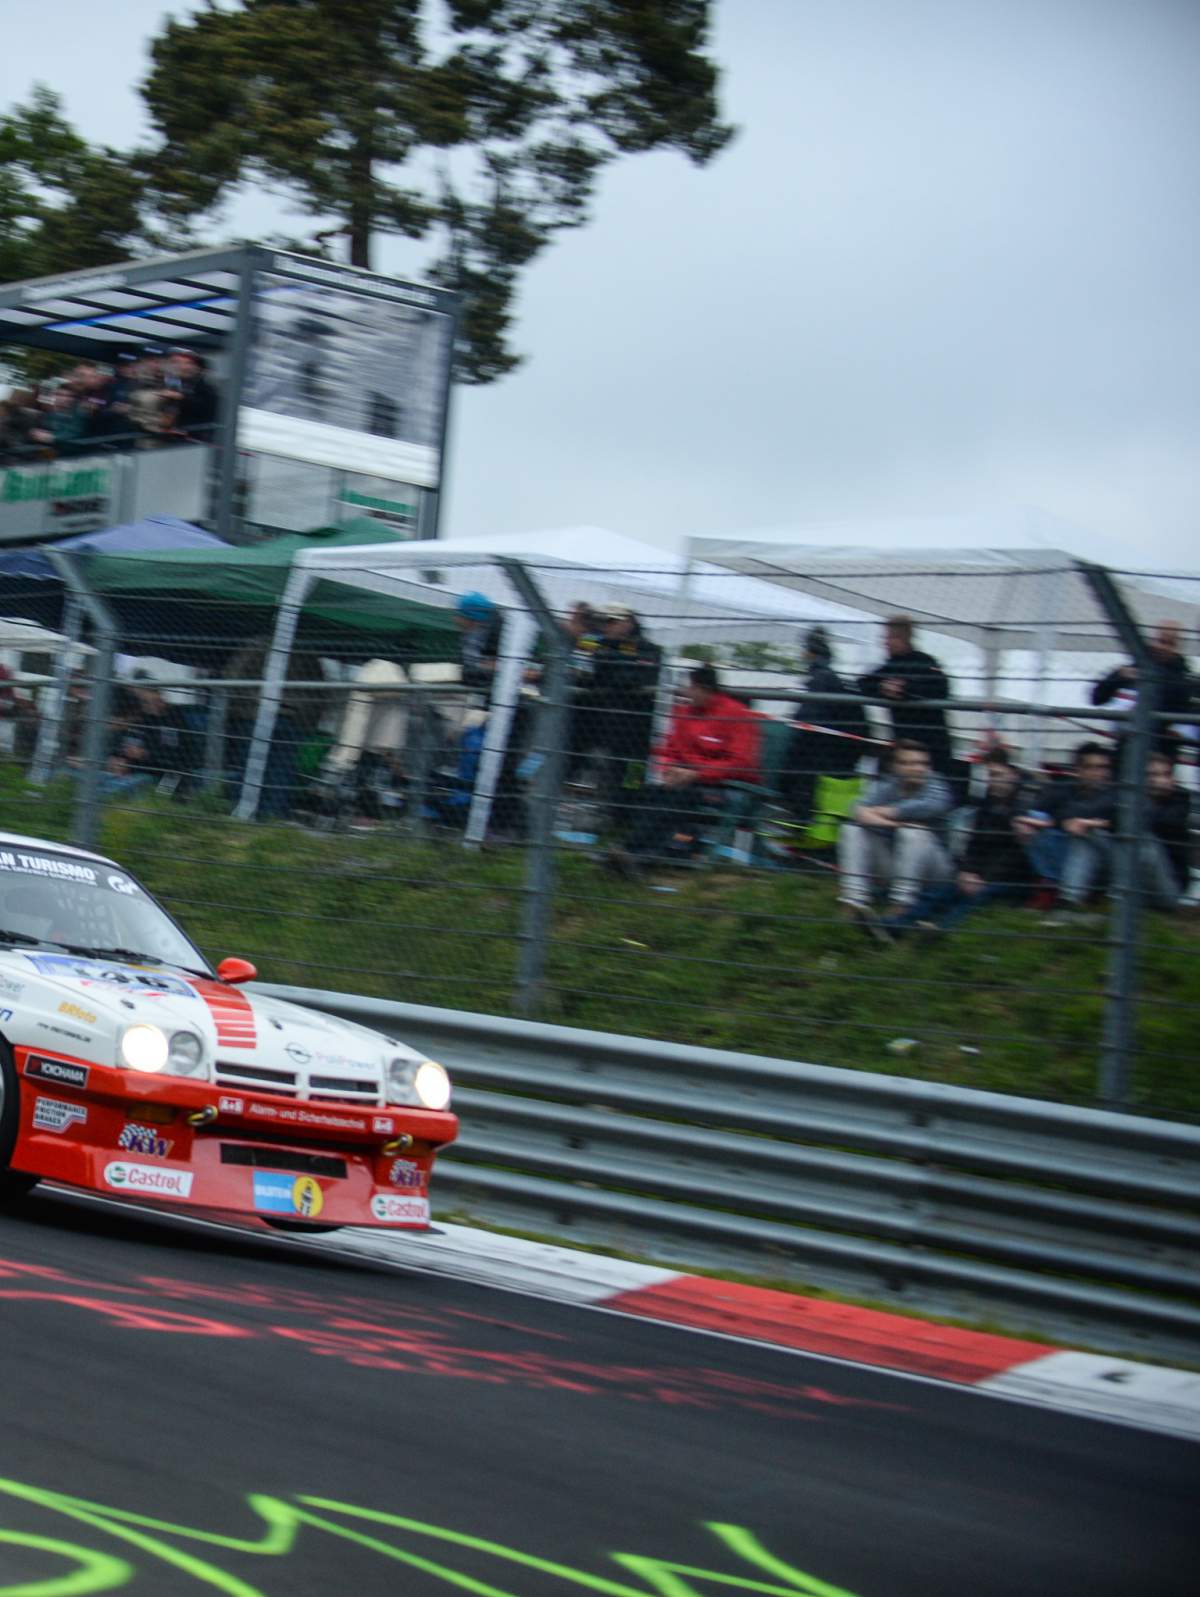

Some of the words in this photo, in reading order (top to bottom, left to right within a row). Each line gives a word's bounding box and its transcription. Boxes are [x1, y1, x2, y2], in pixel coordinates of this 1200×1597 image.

[17, 854, 97, 881] TURISMO
[127, 1133, 170, 1157] KW
[128, 1168, 184, 1194] Castrol
[387, 1200, 427, 1219] Castrol
